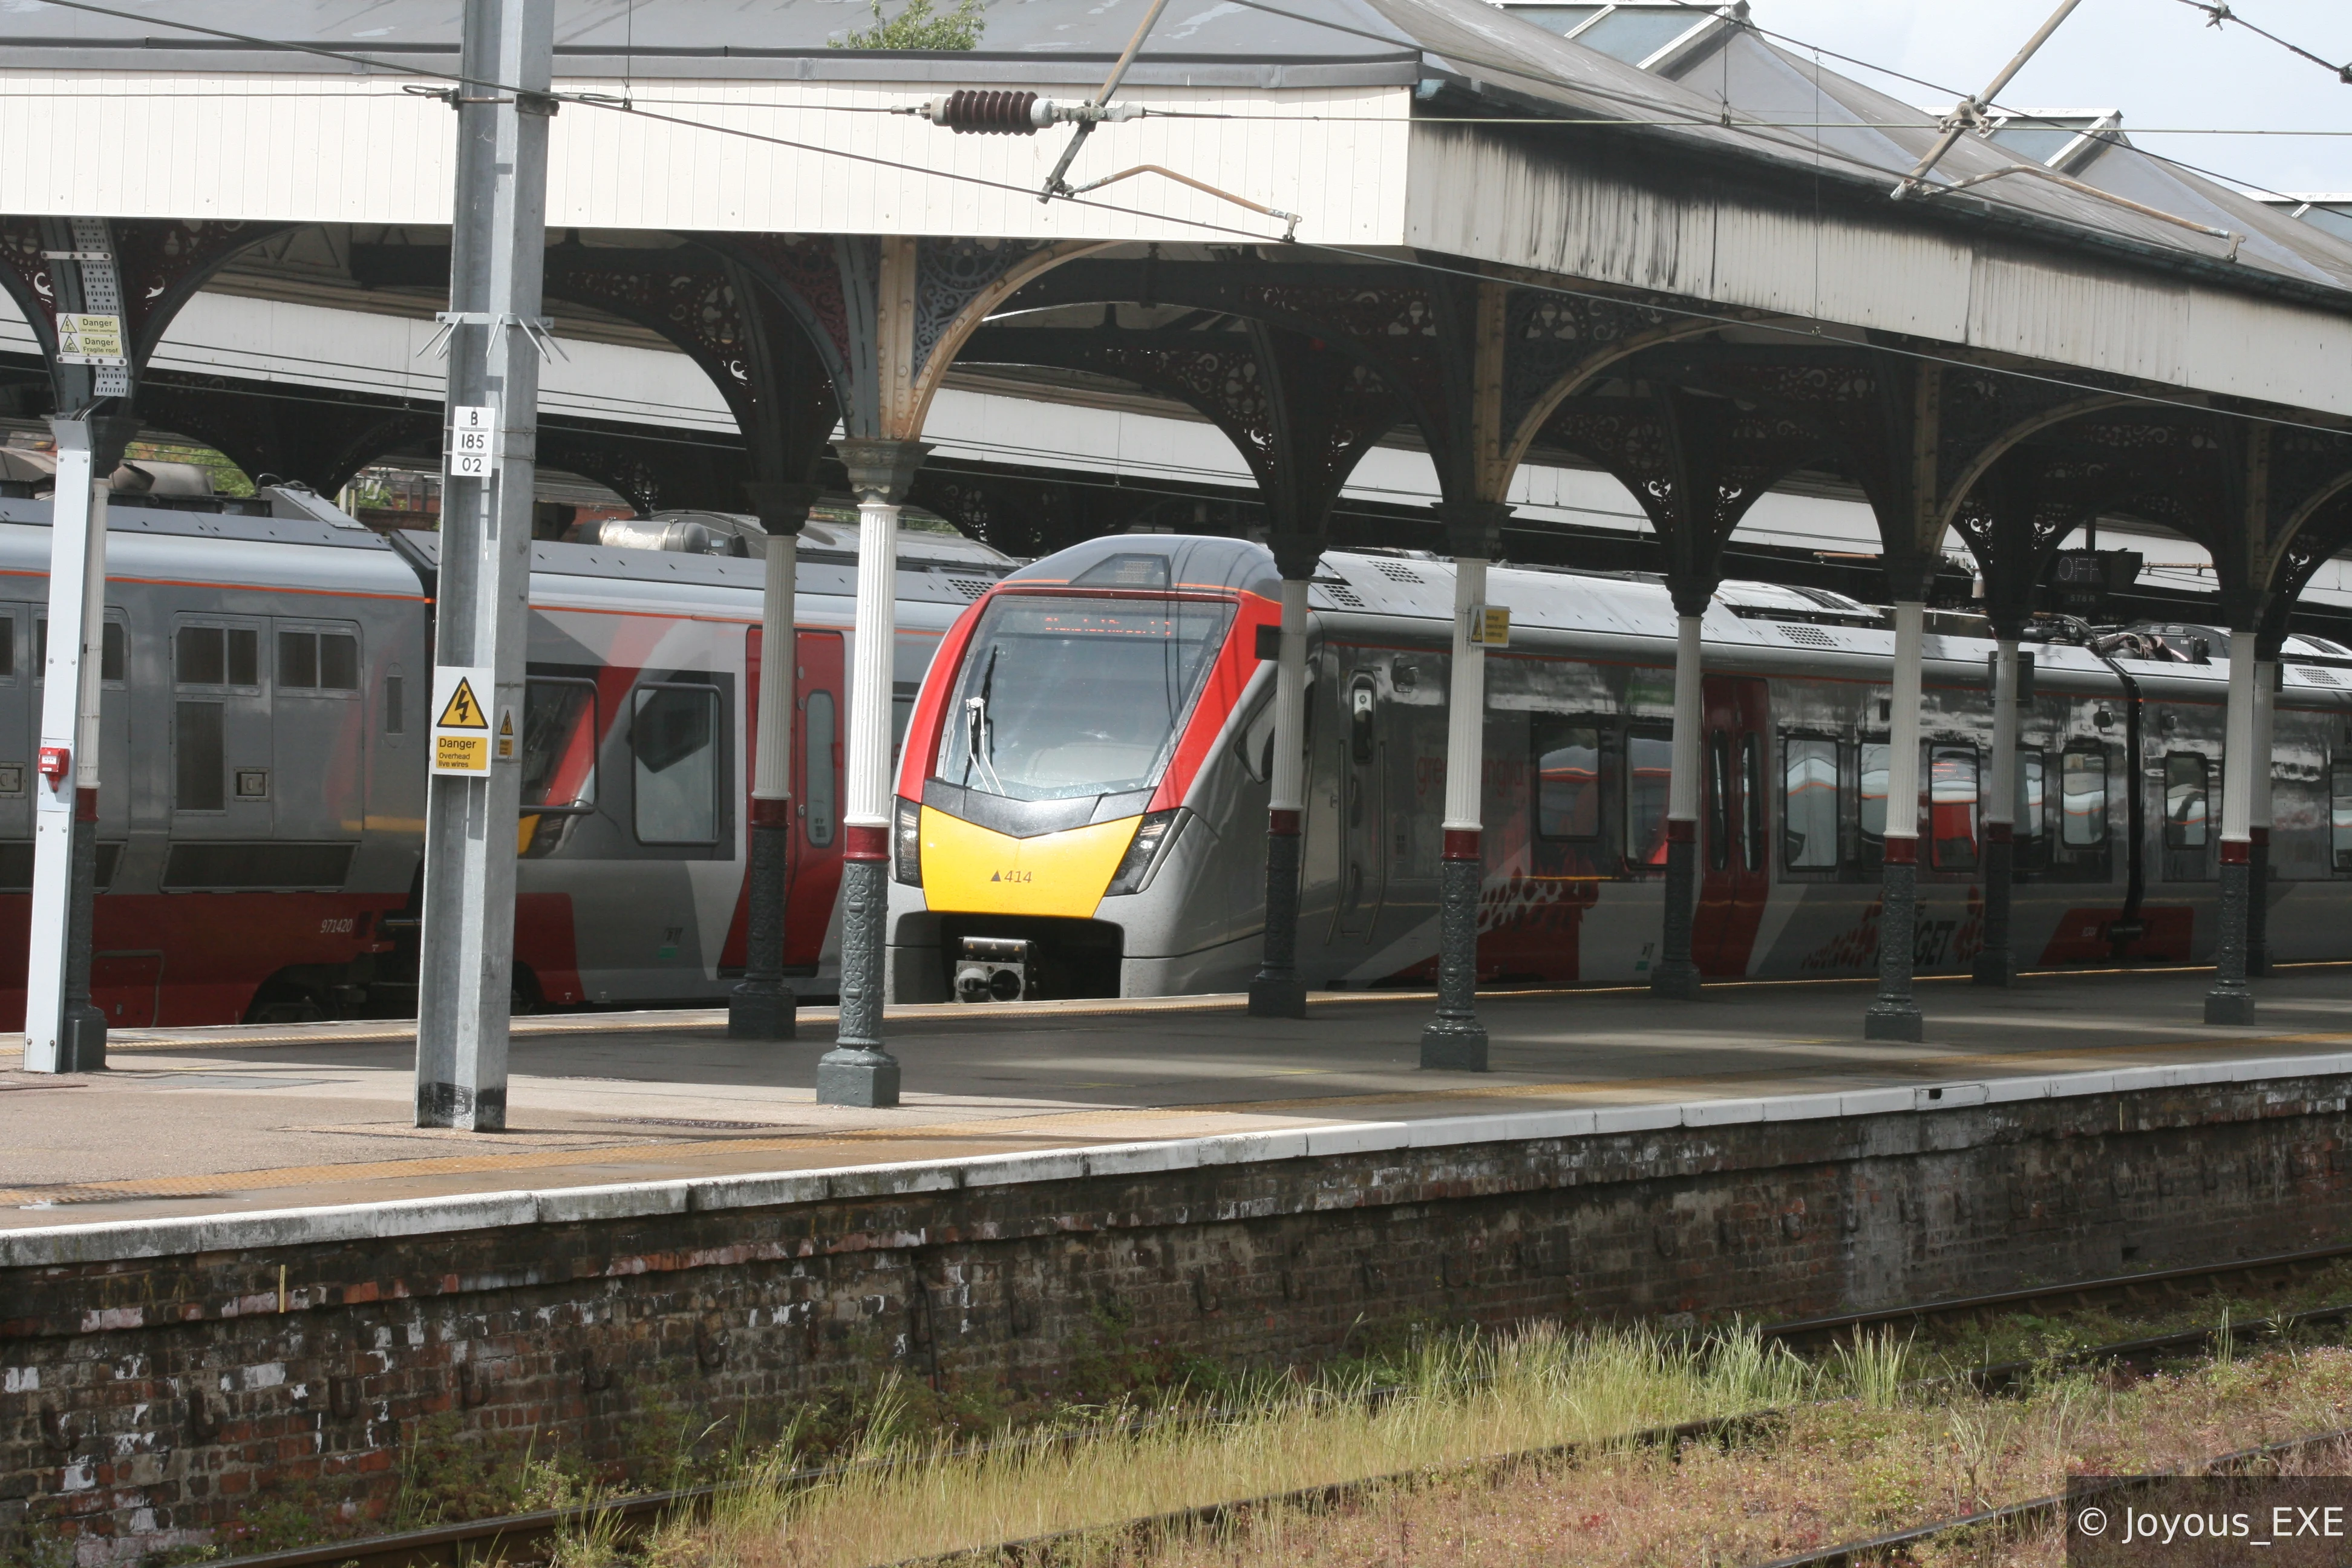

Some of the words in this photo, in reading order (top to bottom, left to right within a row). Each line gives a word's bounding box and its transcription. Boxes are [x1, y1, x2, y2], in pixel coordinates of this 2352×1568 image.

[82, 318, 113, 328] Danger
[85, 338, 114, 347] Danger
[471, 411, 478, 425] B
[461, 434, 485, 449] 185
[462, 457, 482, 472] 02
[2058, 557, 2099, 581] OFF
[439, 737, 476, 750] Danger
[1004, 870, 1032, 884] 414
[320, 918, 353, 933] 971420
